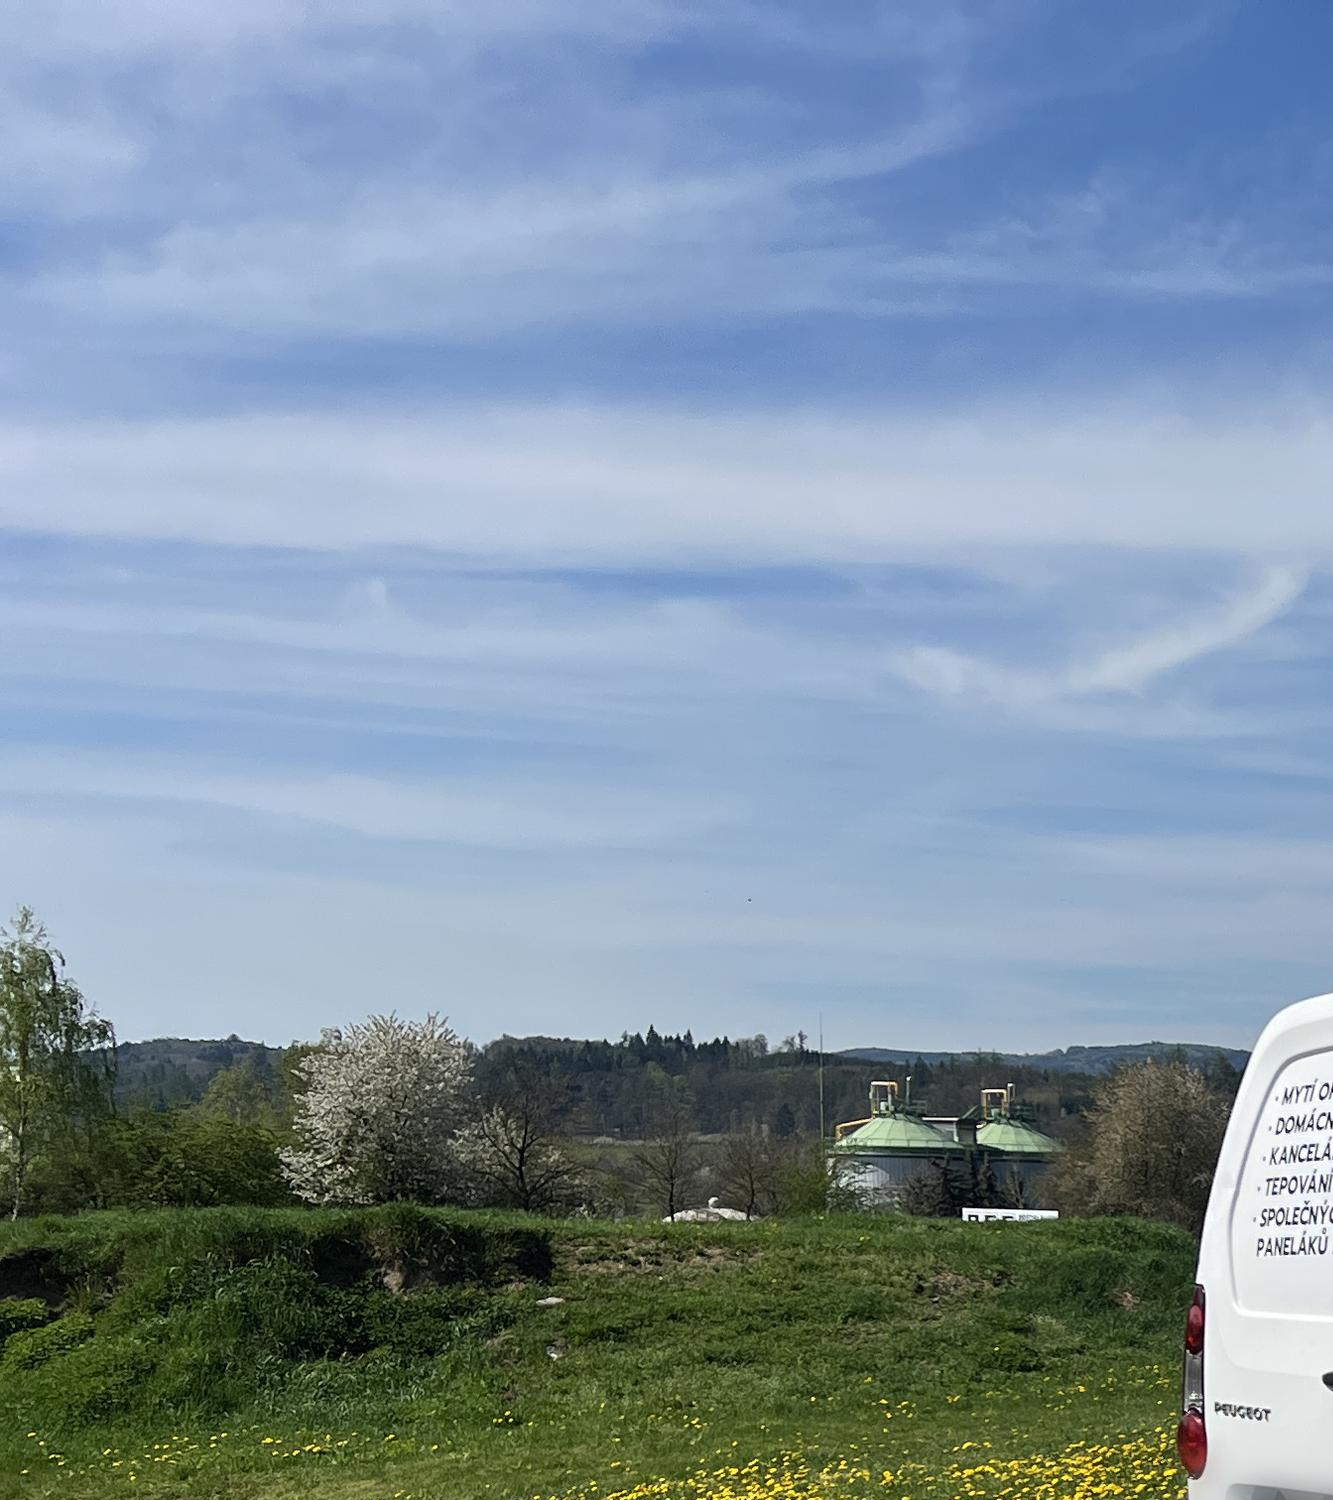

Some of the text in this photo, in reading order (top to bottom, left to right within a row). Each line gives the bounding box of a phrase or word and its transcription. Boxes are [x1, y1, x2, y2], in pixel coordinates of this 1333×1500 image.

[1282, 1079, 1318, 1105] MYTÍ
[1256, 1228, 1328, 1257] PANELÁKŮ
[1214, 1401, 1271, 1422] PEUGEOT
